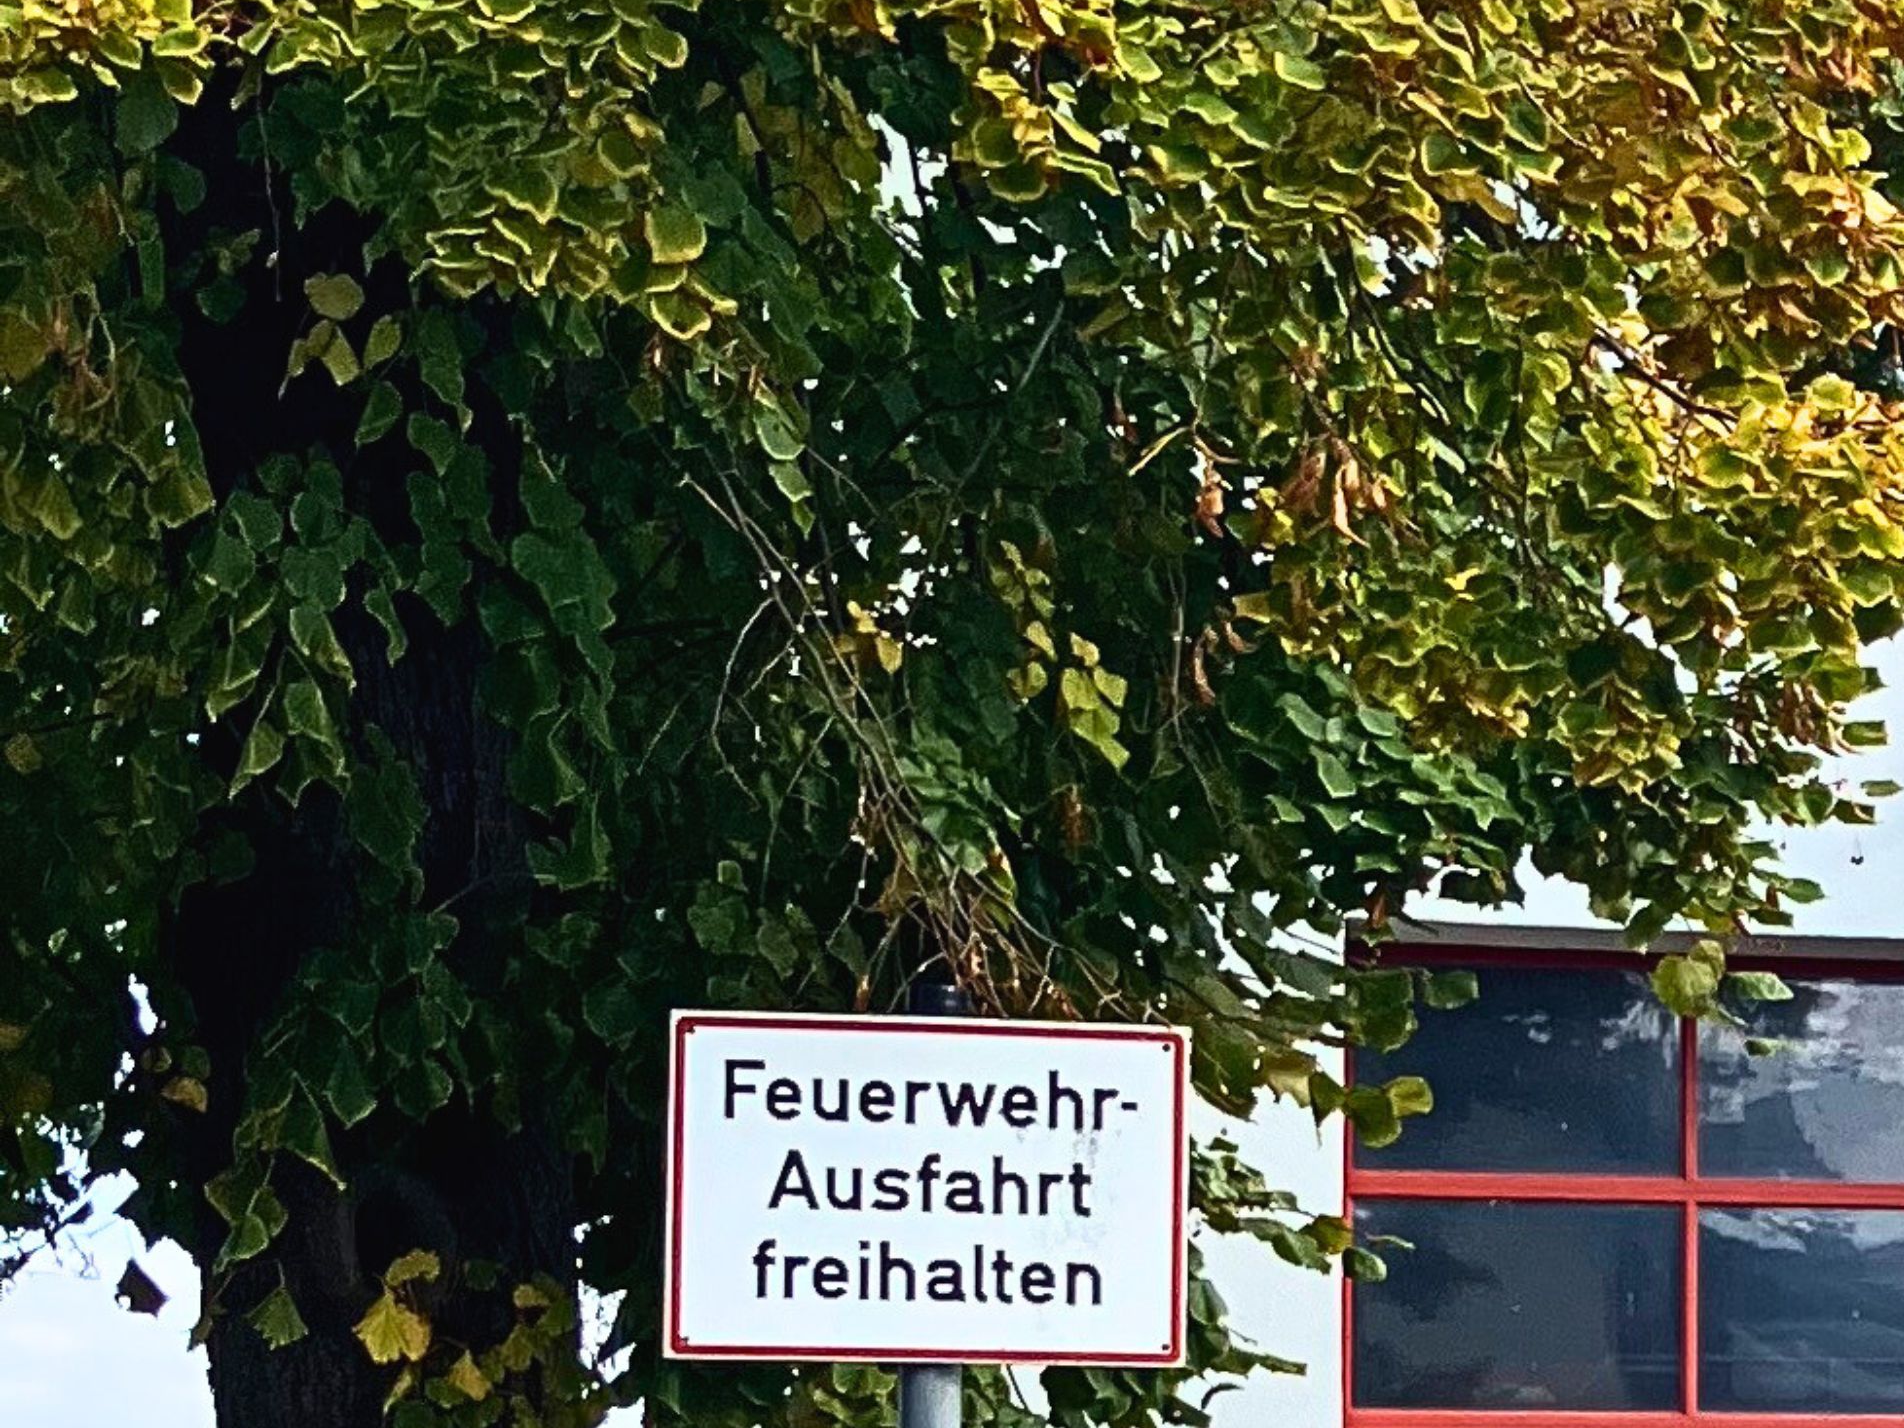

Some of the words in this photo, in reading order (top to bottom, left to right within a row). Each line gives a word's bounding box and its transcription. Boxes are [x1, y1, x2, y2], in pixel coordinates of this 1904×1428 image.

[723, 1058, 1140, 1132] Feuerwehr-
[767, 1148, 1092, 1218] Ausfahrt
[751, 1238, 1102, 1306] freihalten
